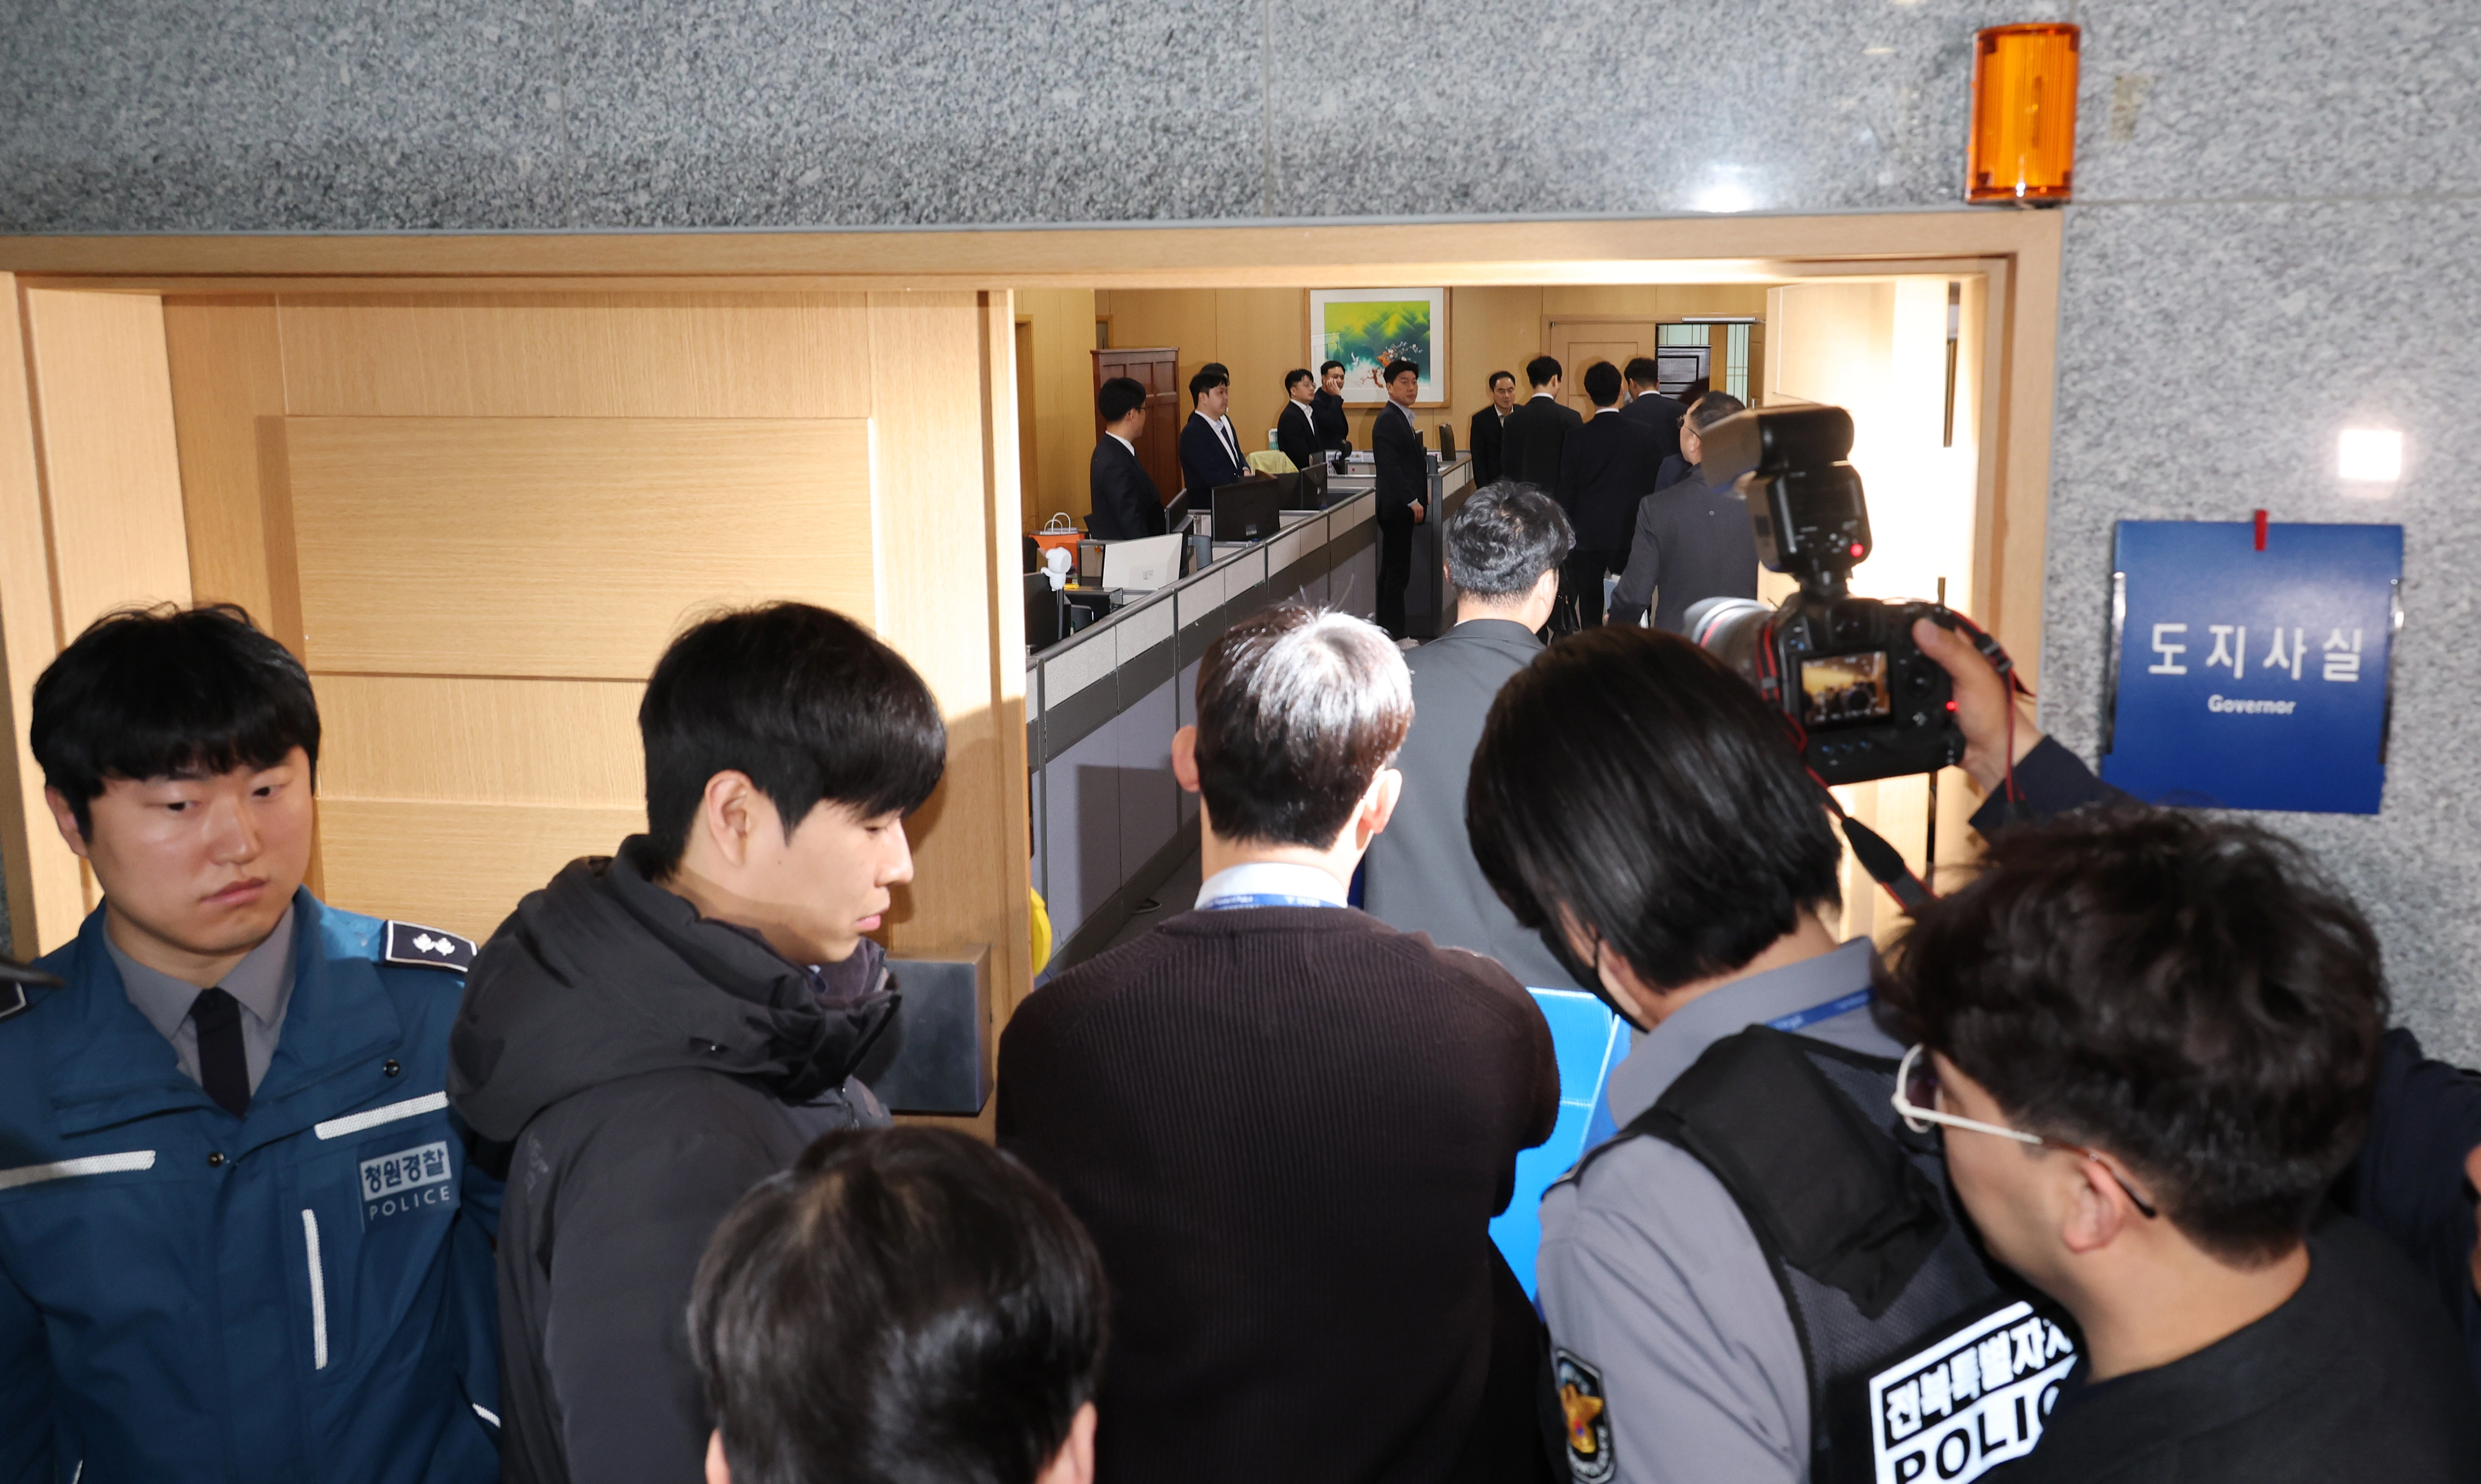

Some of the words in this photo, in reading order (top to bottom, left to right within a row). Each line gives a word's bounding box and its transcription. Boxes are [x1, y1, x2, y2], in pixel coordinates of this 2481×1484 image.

[2148, 623, 2362, 682] 도지사실
[2207, 694, 2296, 715] Governor
[365, 1149, 445, 1193] 청원경찰
[369, 1185, 451, 1221] POLICE
